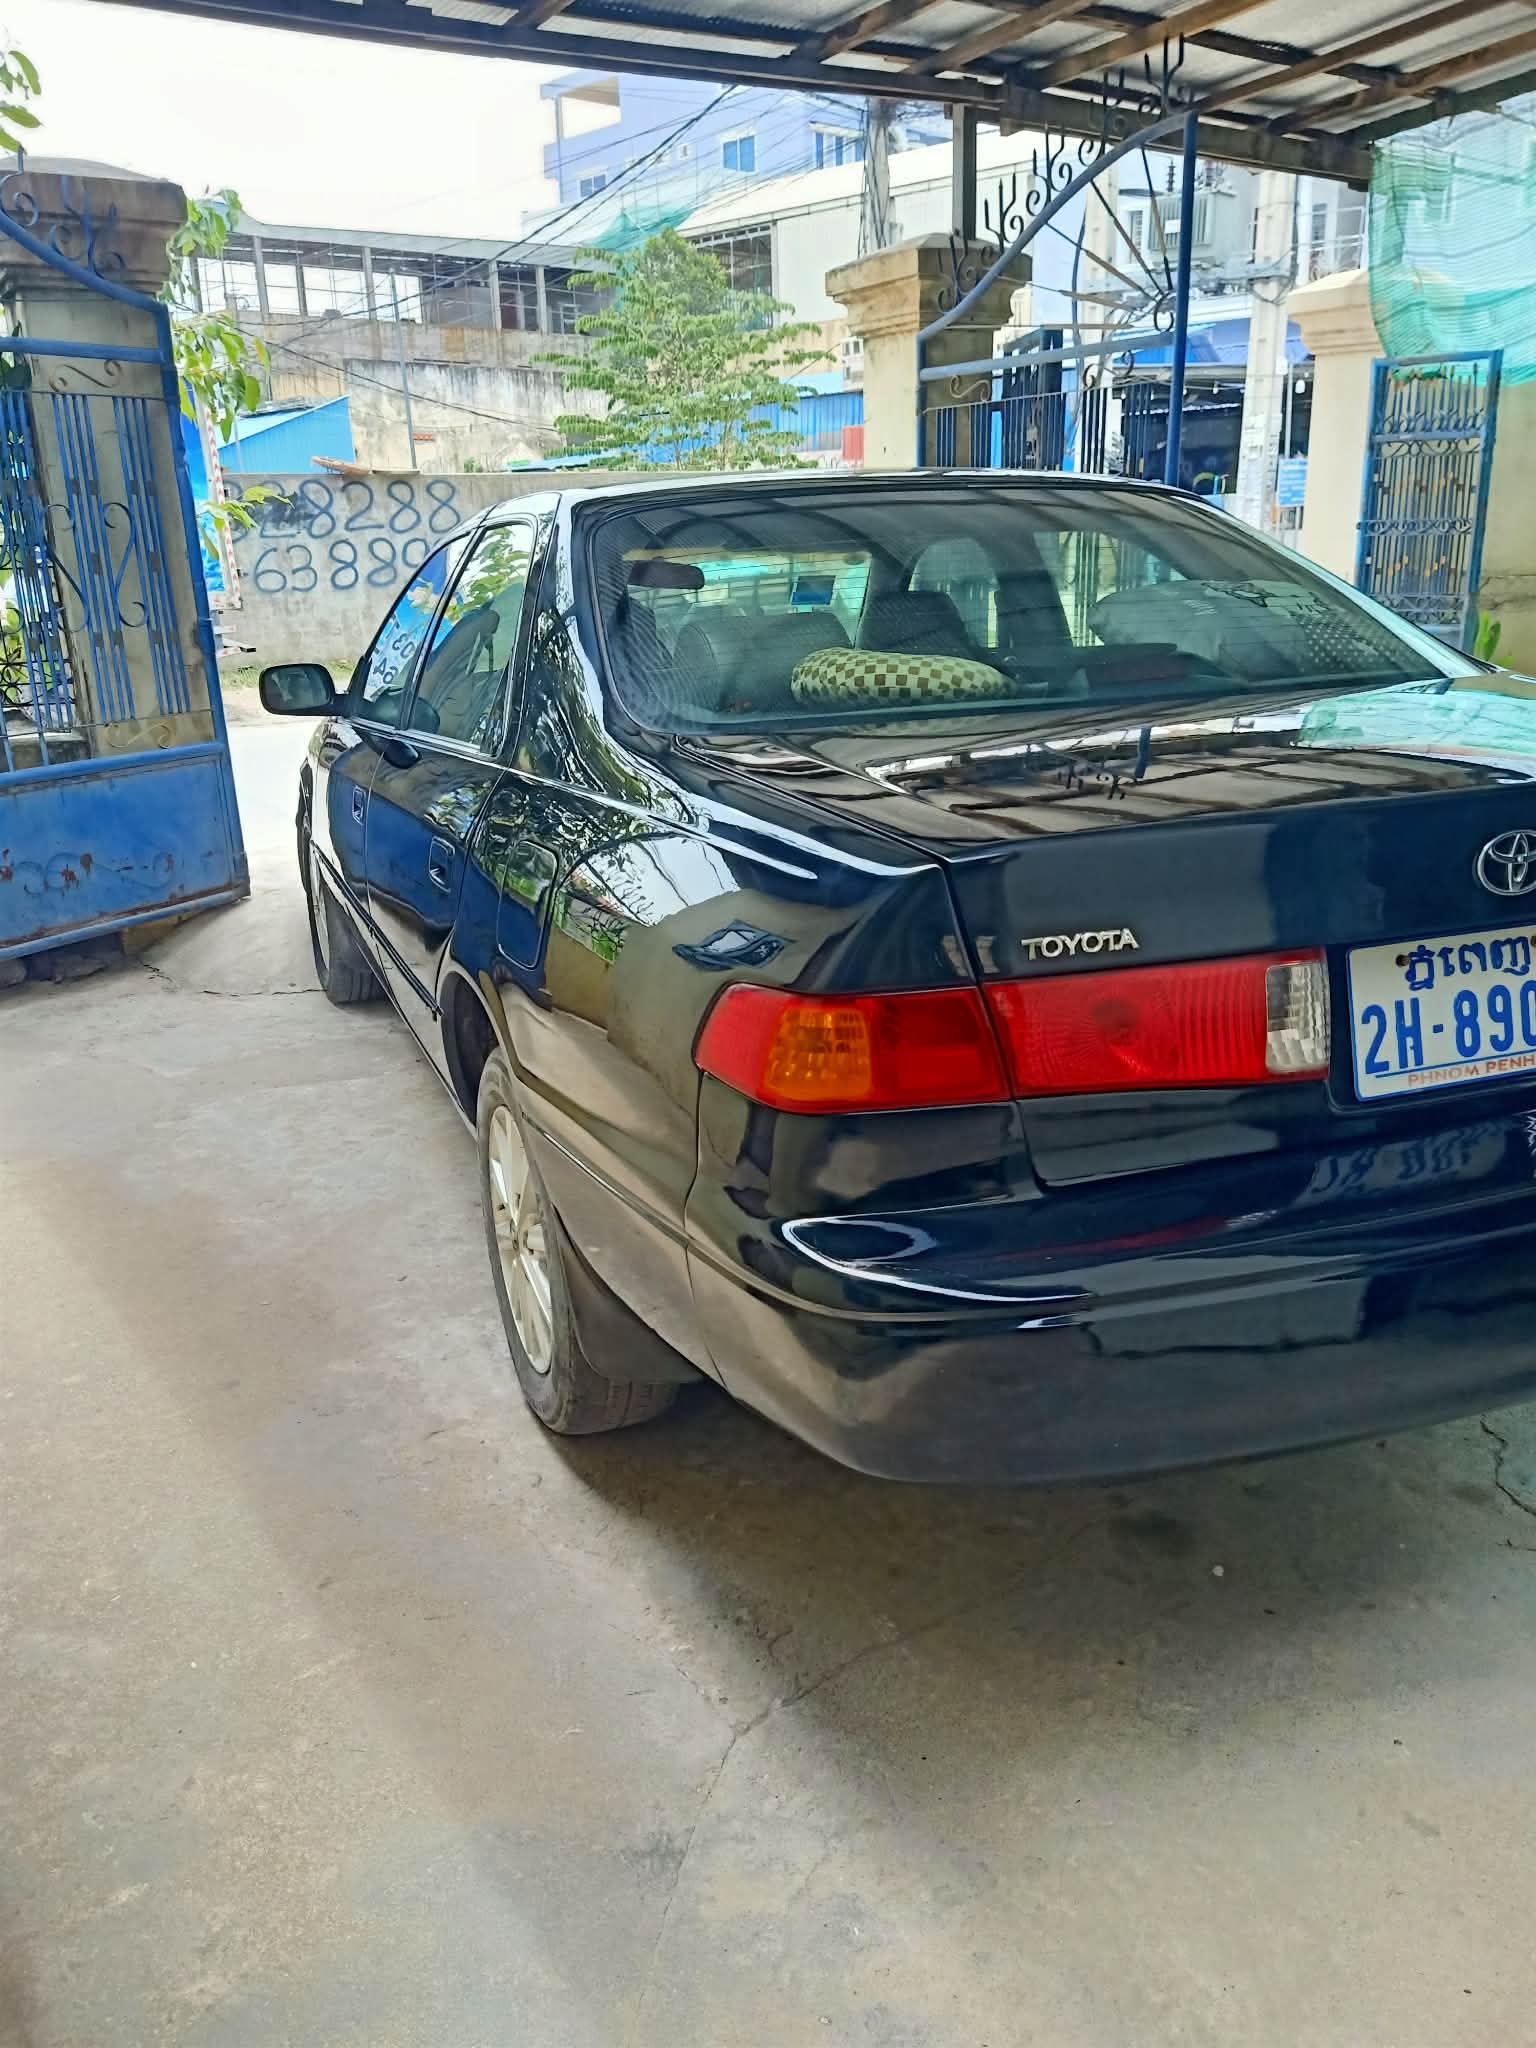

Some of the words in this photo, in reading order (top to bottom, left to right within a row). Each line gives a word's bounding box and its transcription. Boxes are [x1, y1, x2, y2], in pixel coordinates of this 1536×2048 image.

[1021, 927, 1140, 960] TOYOTA
[1405, 936, 1531, 991] ភ្នំពេញ
[1408, 1064, 1480, 1087] PHNOM
[1485, 1054, 1536, 1074] PENH
